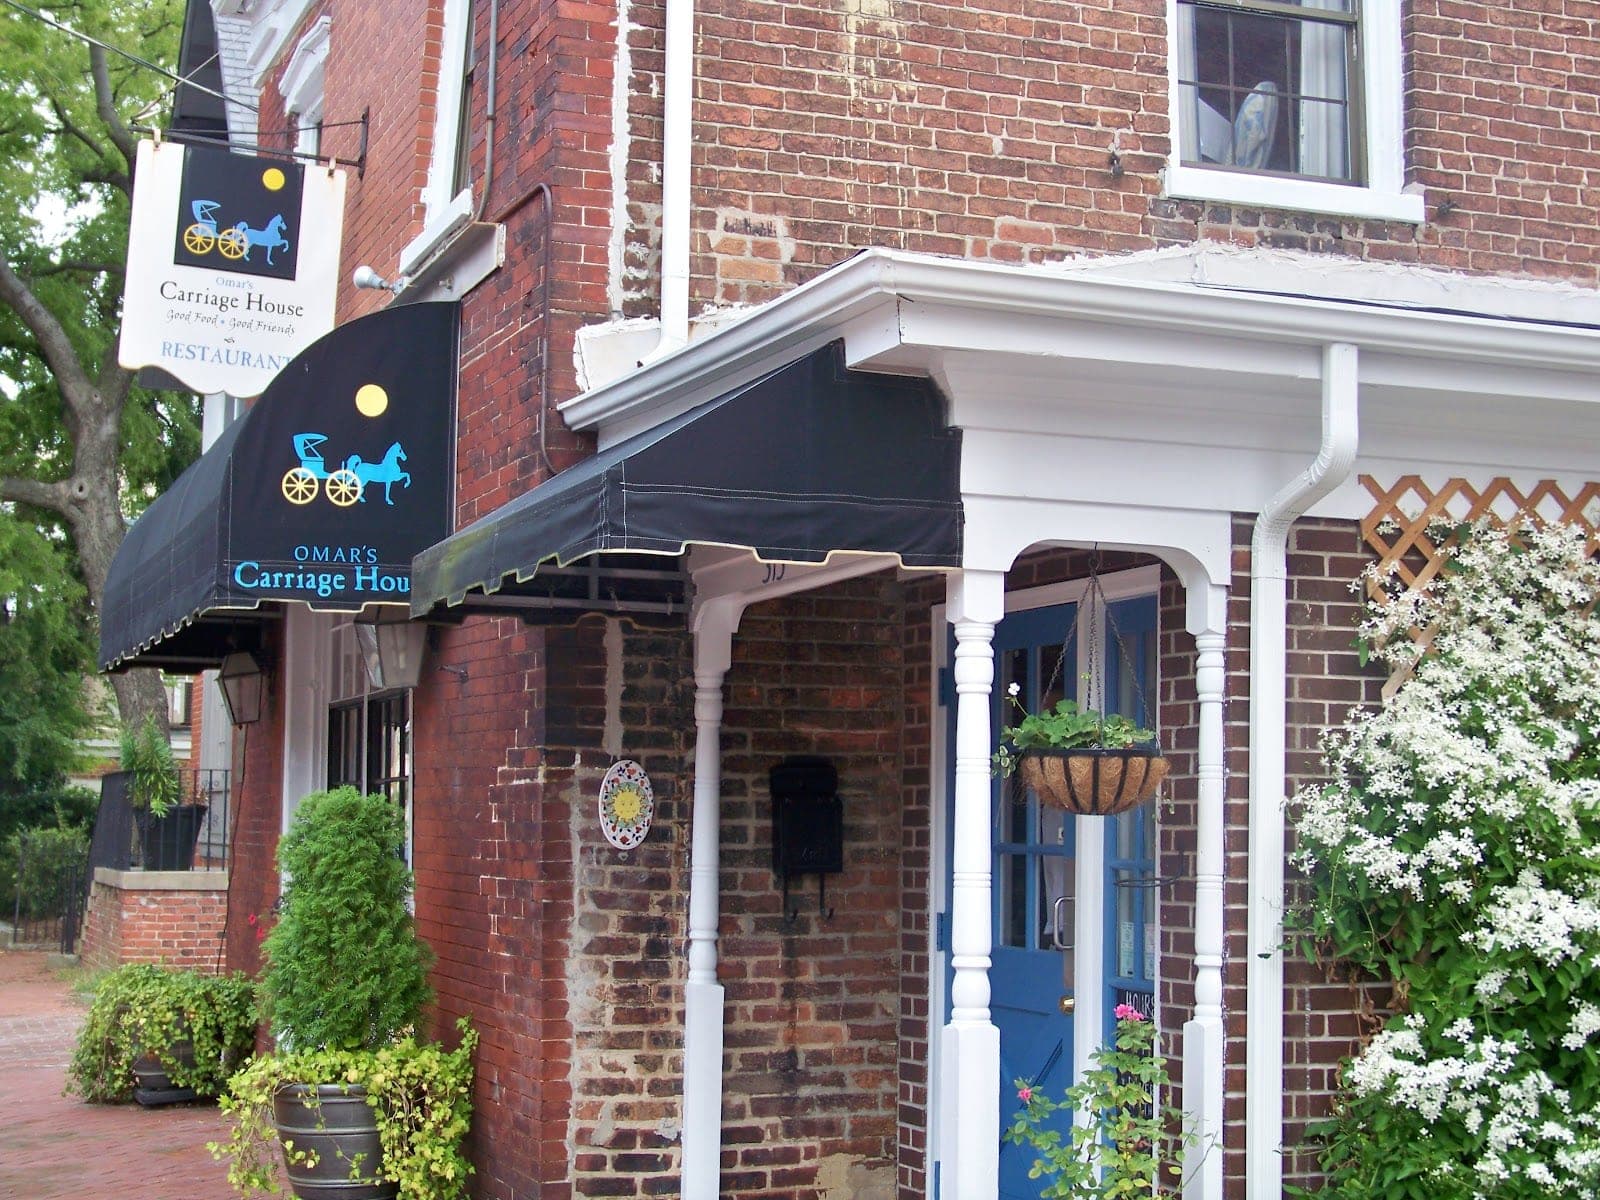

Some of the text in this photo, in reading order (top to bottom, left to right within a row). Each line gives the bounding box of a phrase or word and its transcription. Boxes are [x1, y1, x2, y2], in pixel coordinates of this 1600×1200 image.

[215, 276, 254, 290] Omar's
[160, 280, 304, 318] Carriage House
[166, 309, 296, 338] Good Food Good Friends
[294, 545, 378, 564] OMAR'S
[234, 561, 410, 597] Carriage Hou
